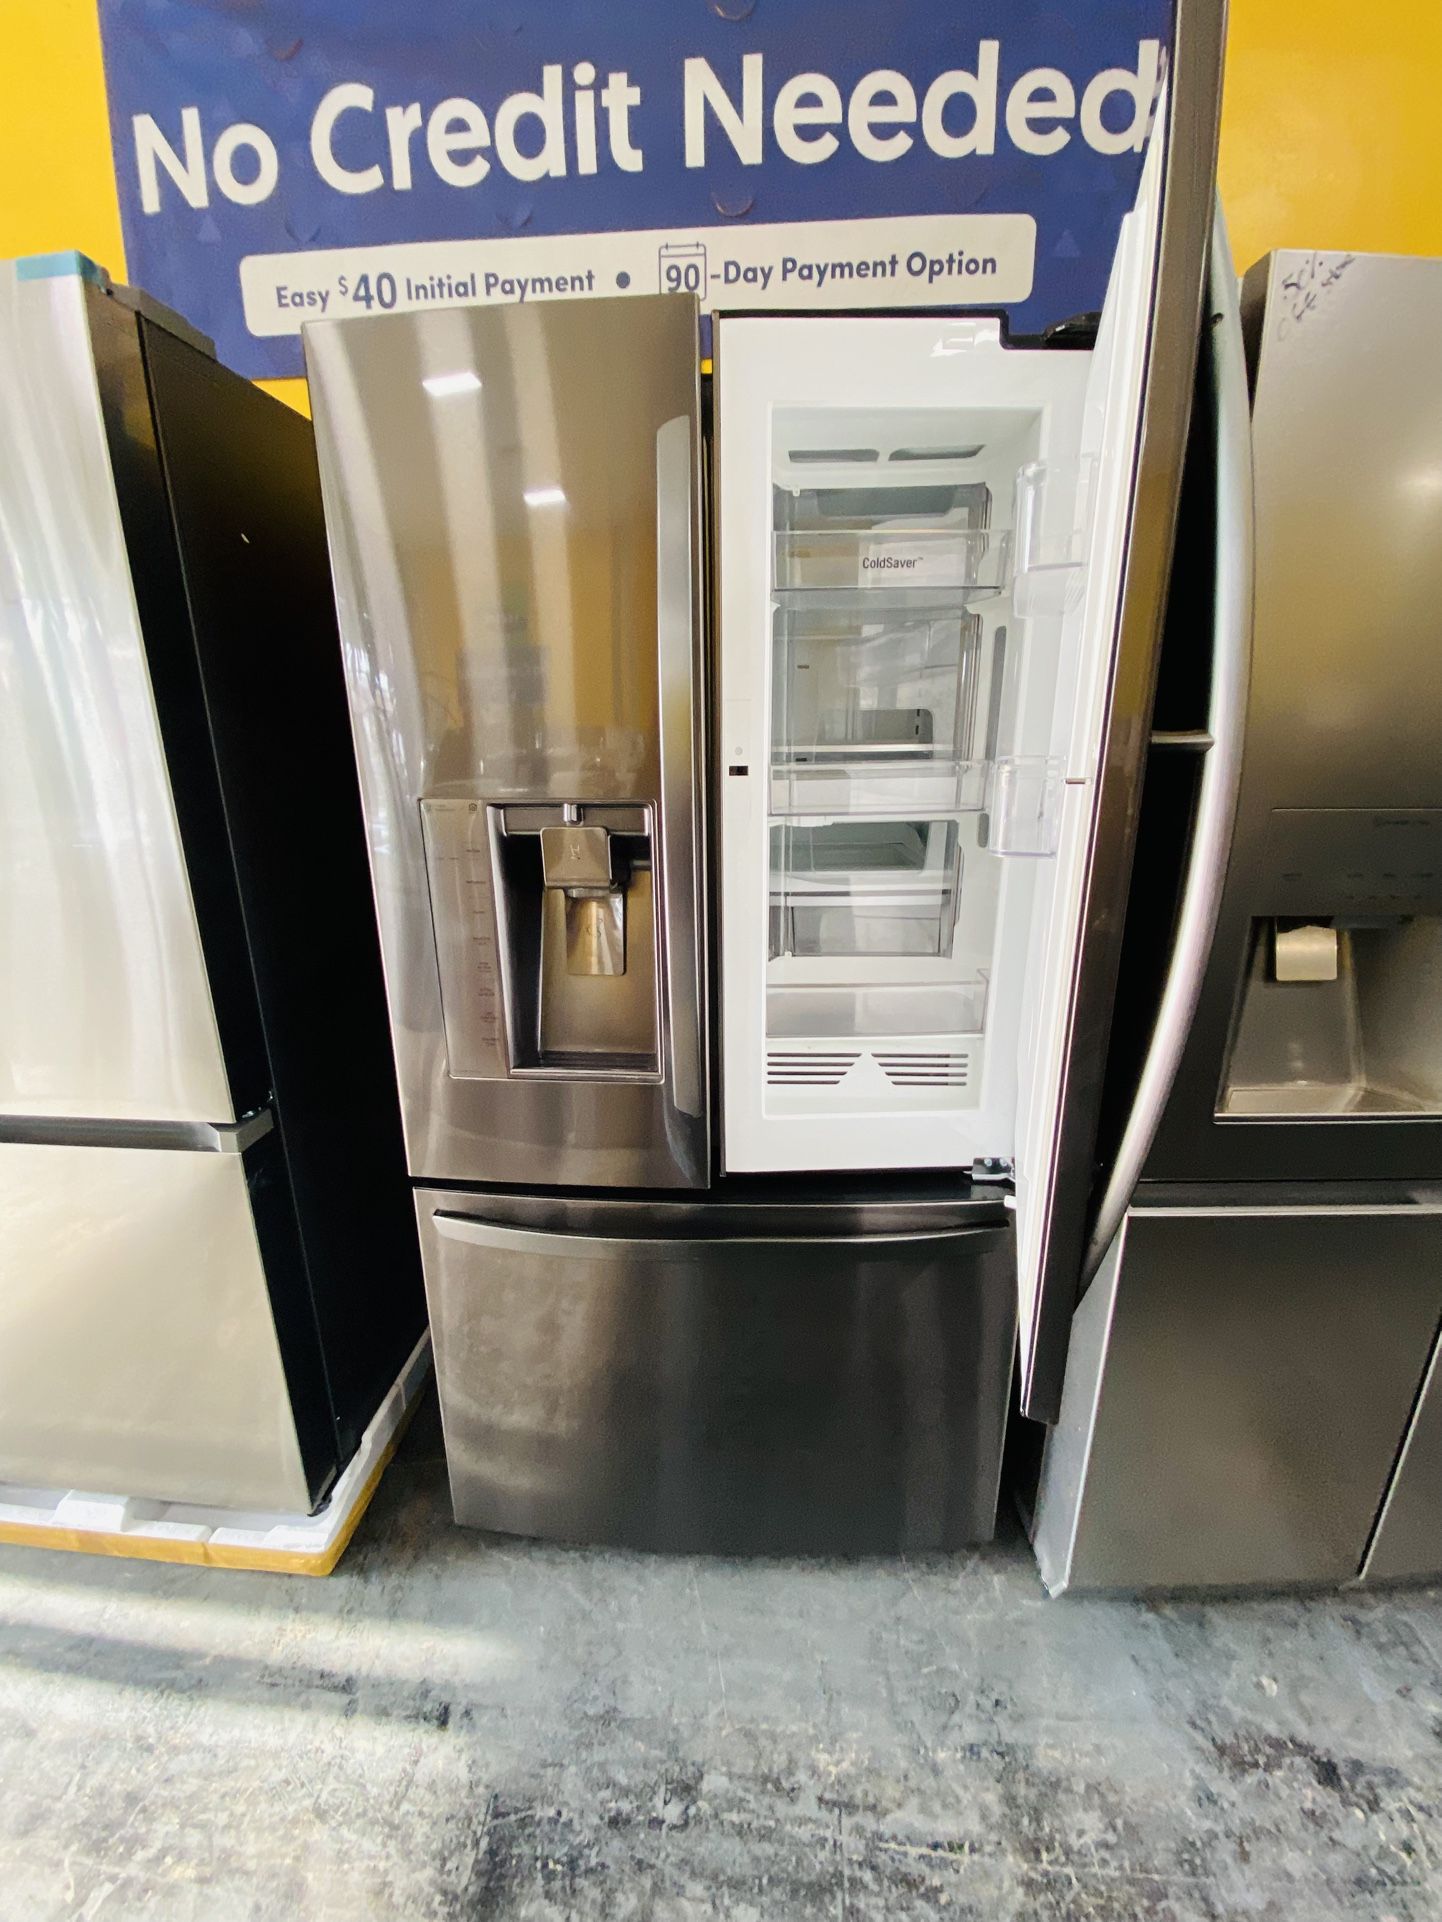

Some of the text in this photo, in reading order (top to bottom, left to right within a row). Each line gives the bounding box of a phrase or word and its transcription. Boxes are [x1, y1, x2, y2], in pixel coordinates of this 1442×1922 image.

[133, 39, 1160, 215] No Credit Needed
[275, 269, 596, 313] Easy $40 Initial Payment
[781, 253, 899, 288] Payment
[906, 250, 998, 284] Option
